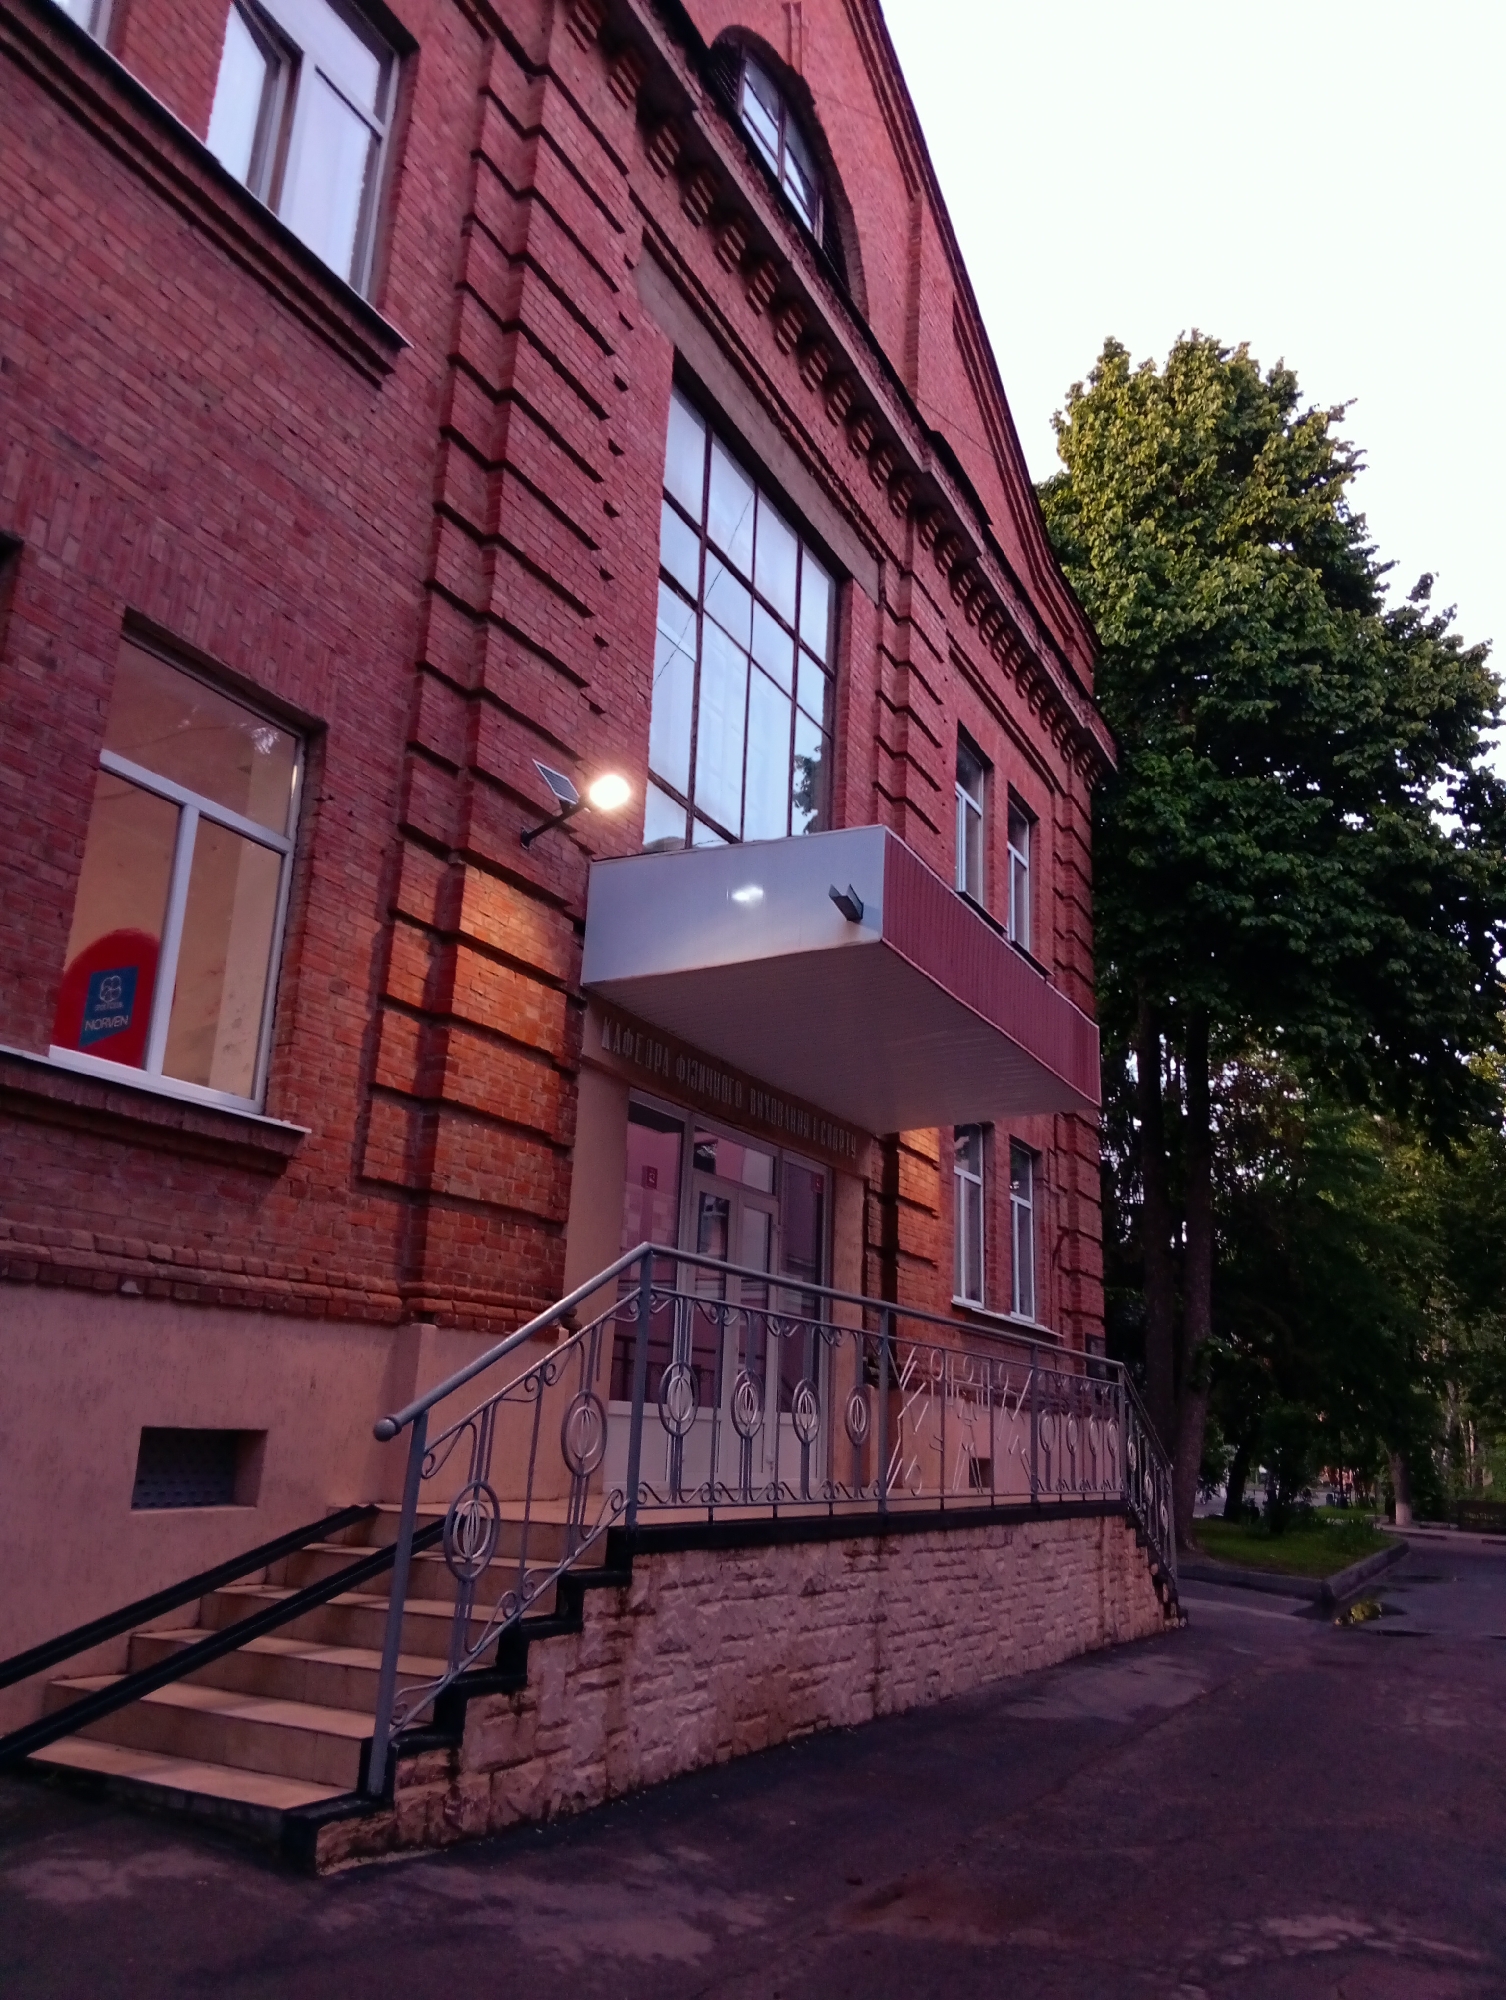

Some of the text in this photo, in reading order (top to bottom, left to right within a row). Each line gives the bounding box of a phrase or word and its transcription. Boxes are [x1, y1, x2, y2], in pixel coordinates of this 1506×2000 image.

[84, 1015, 129, 1031] NORVEN
[601, 1016, 669, 1078] КАФЕДРА
[676, 1054, 742, 1108] ФІЗИЧНОГО
[750, 1088, 809, 1139] ВИХОВАННЯ
[821, 1120, 856, 1159] СПОРТУ
